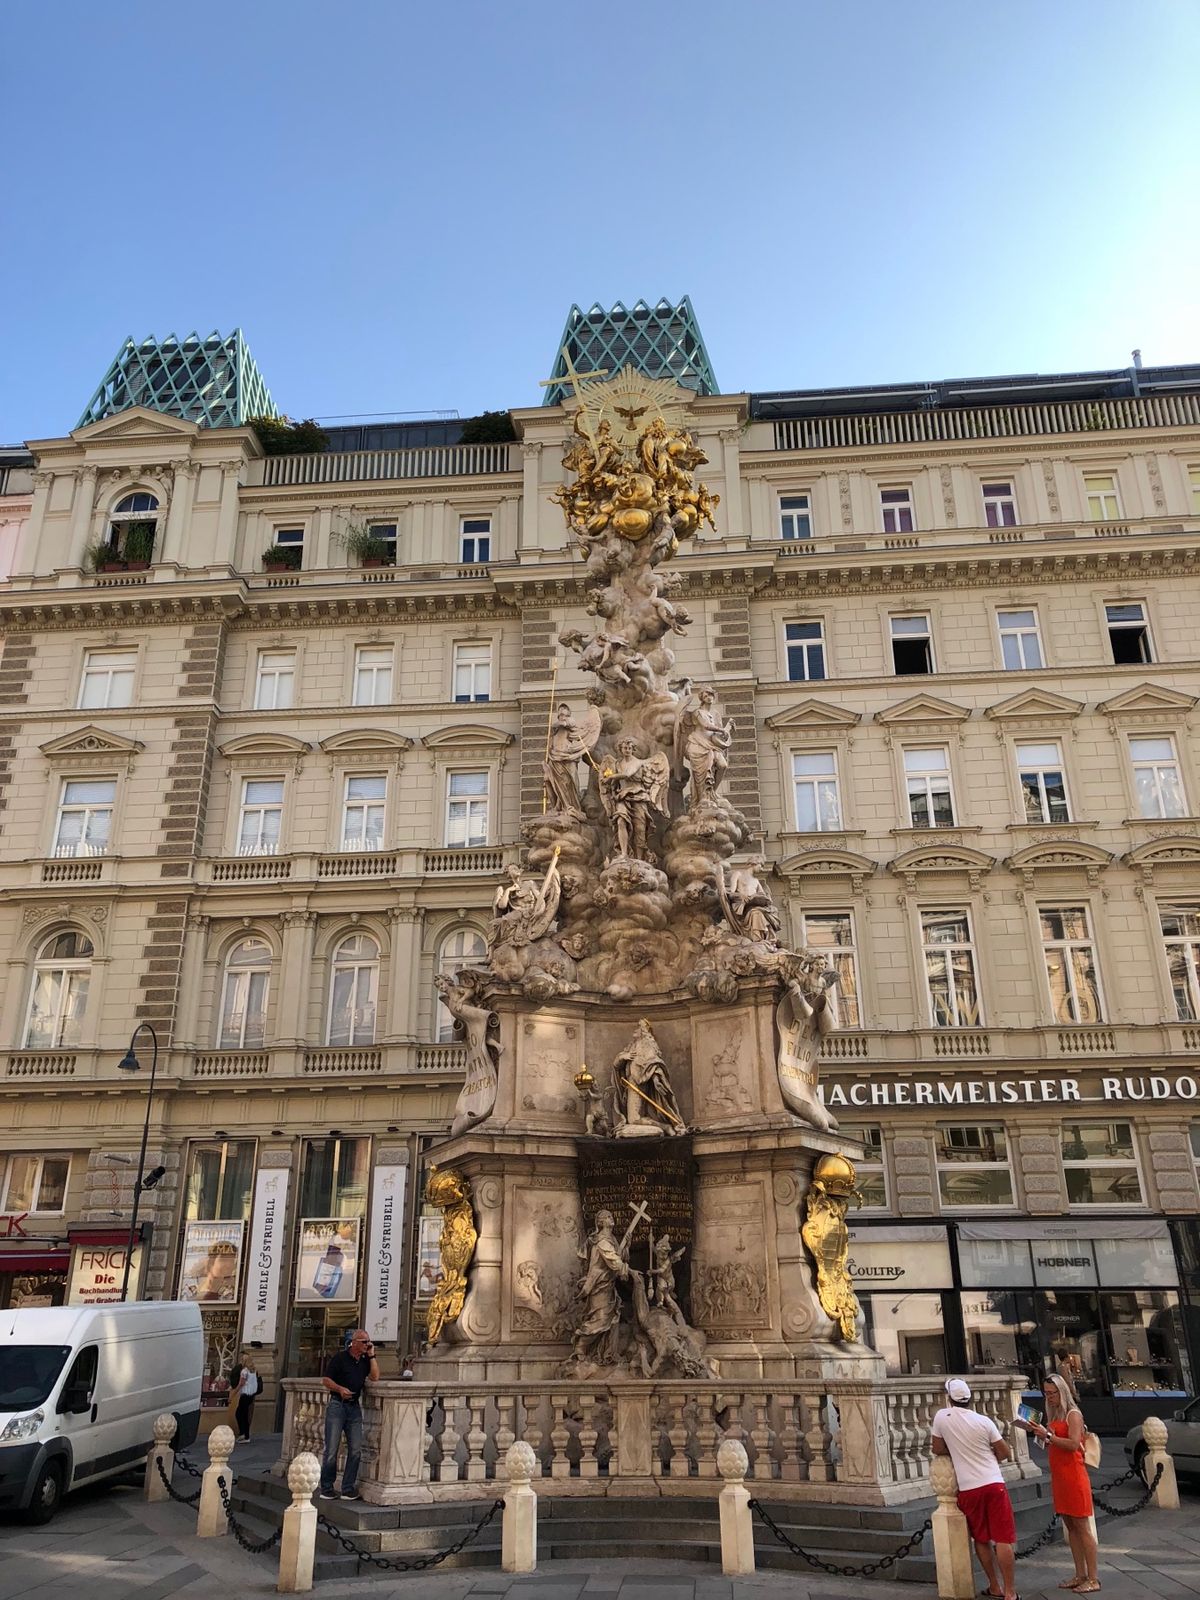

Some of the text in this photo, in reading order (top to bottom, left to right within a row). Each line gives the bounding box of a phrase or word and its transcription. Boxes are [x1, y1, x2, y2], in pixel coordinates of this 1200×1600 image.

[787, 1041, 811, 1062] FILIO
[1102, 1076, 1198, 1100] RUDO
[628, 1174, 648, 1184] DEO
[262, 1198, 276, 1252] STRUBELL
[382, 1195, 394, 1249] STRUBELL
[1038, 1257, 1091, 1268] HÜBNER
[94, 1274, 115, 1284] Die
[256, 1270, 270, 1312] NÄGELE
[378, 1268, 390, 1309] NÄGELE
